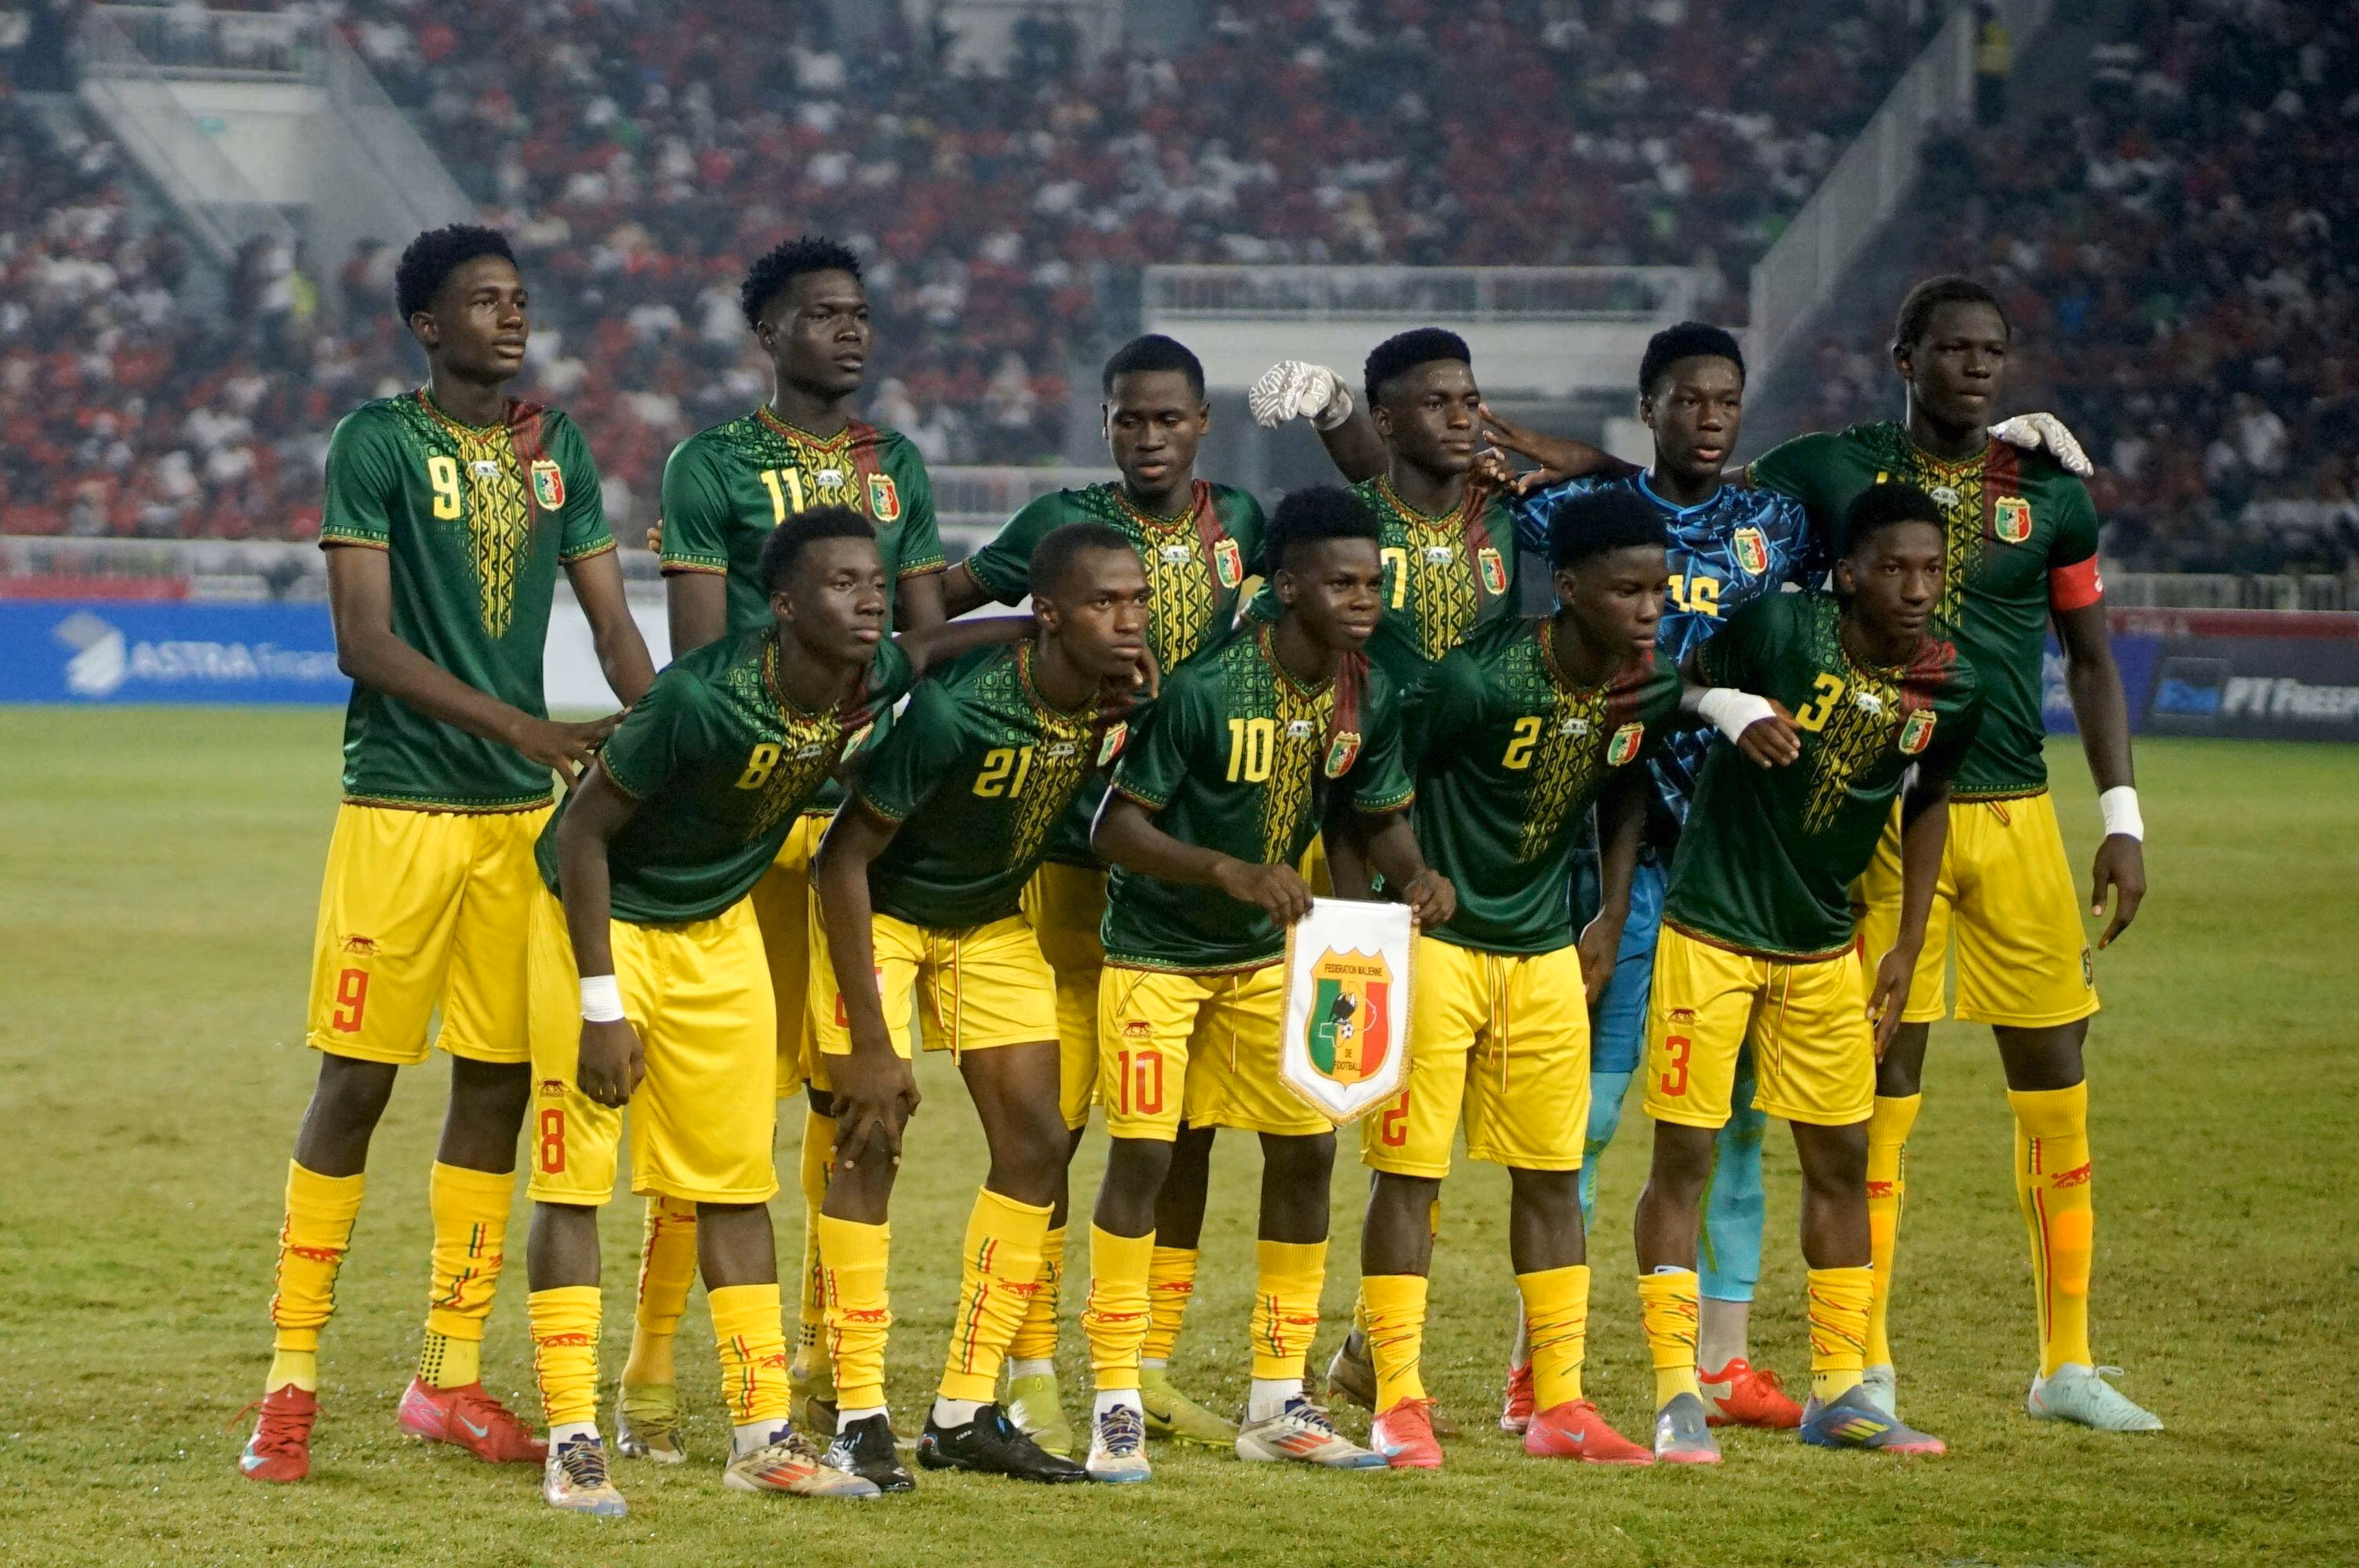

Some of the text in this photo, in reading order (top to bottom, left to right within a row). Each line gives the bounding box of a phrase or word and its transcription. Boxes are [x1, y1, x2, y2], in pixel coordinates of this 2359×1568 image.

[427, 456, 462, 521] 9
[760, 467, 805, 525] 11
[1380, 547, 1408, 609] 7
[131, 640, 260, 678] ASTRA
[1794, 672, 1846, 733] 3
[2223, 677, 2274, 713] PT
[735, 742, 783, 789] 8
[1226, 717, 1275, 782] 10
[1501, 716, 1543, 769] 2
[972, 746, 1034, 798] 21
[333, 968, 369, 1033] 9
[1332, 1059, 1362, 1072] FOOTBALL
[1344, 1048, 1353, 1058] DE
[1660, 1035, 1692, 1097] 3
[1118, 1050, 1163, 1115] 10
[540, 1109, 565, 1174] 8
[1381, 1088, 1410, 1147] 2
[955, 1430, 973, 1441] COPA
